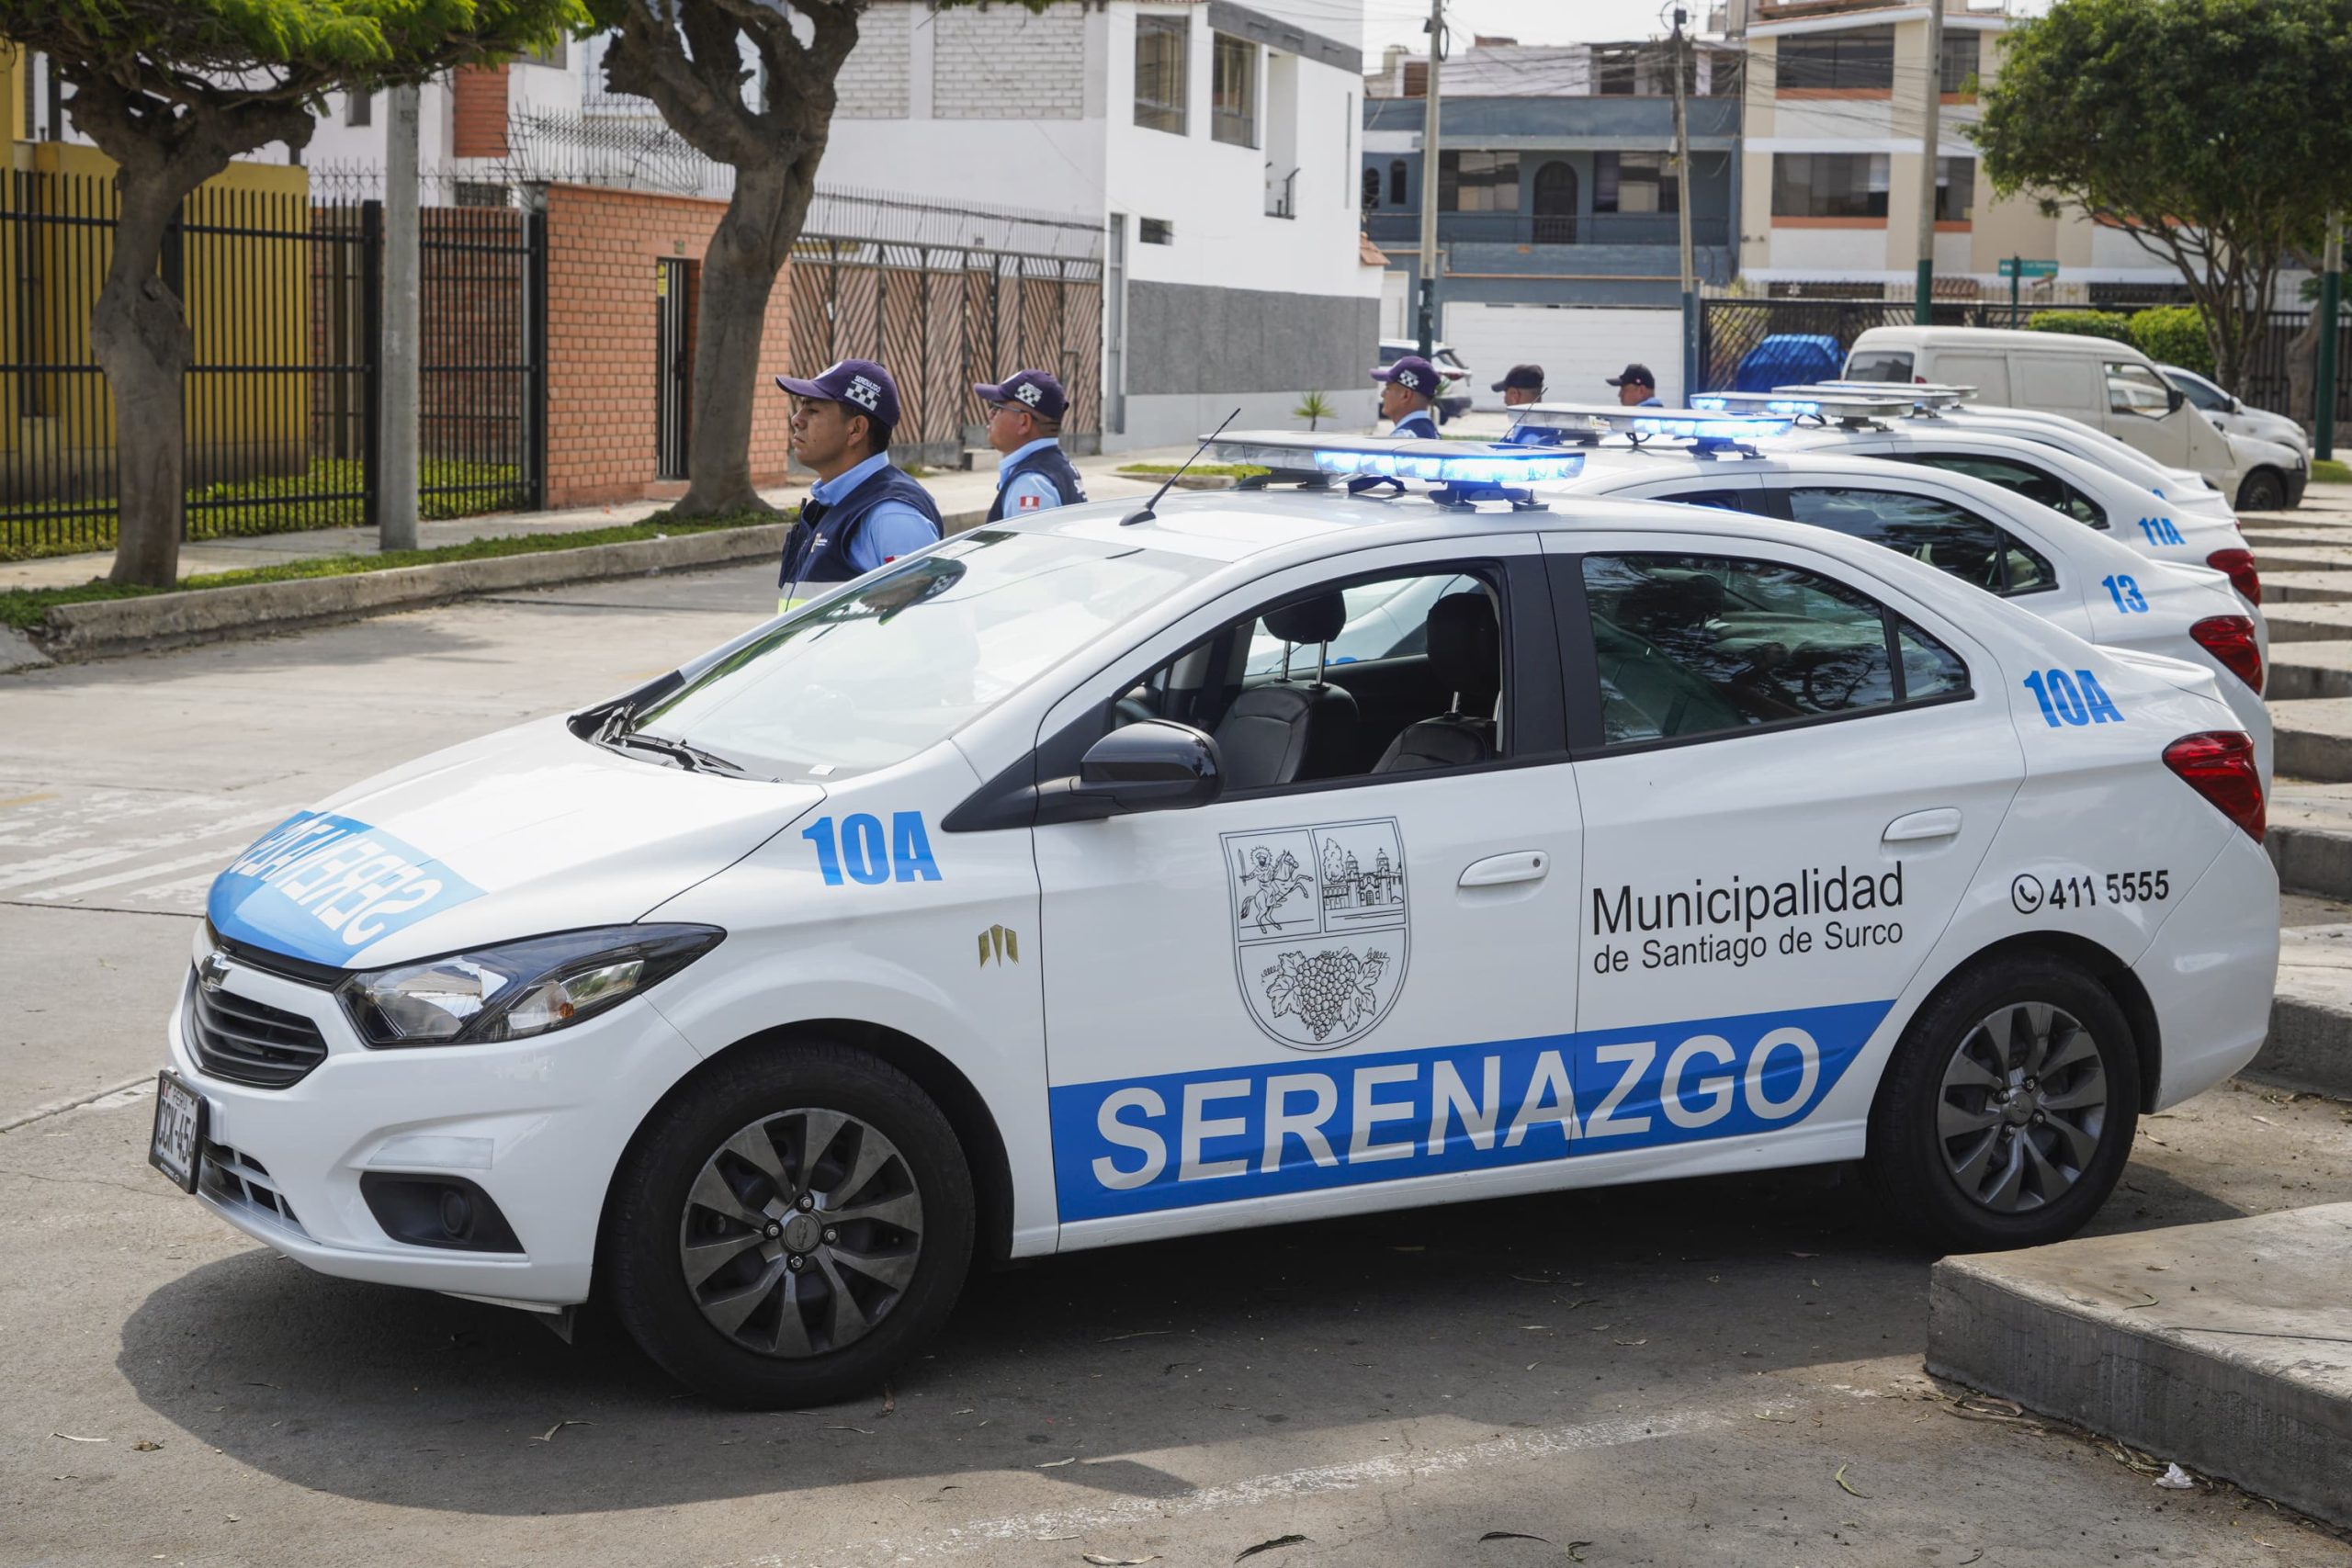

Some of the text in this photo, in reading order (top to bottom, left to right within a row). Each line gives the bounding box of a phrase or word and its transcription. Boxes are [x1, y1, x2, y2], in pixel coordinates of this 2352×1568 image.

[2138, 517, 2186, 547] 11A
[2102, 574, 2149, 614] 13
[2023, 669, 2125, 728] 10A
[802, 810, 943, 886] 10A
[1592, 861, 1903, 935] Municipalidad
[2049, 870, 2169, 909] 411 5555
[1593, 921, 1903, 974] de Santiago de Surco
[1091, 1026, 1820, 1190] SERENAZGO
